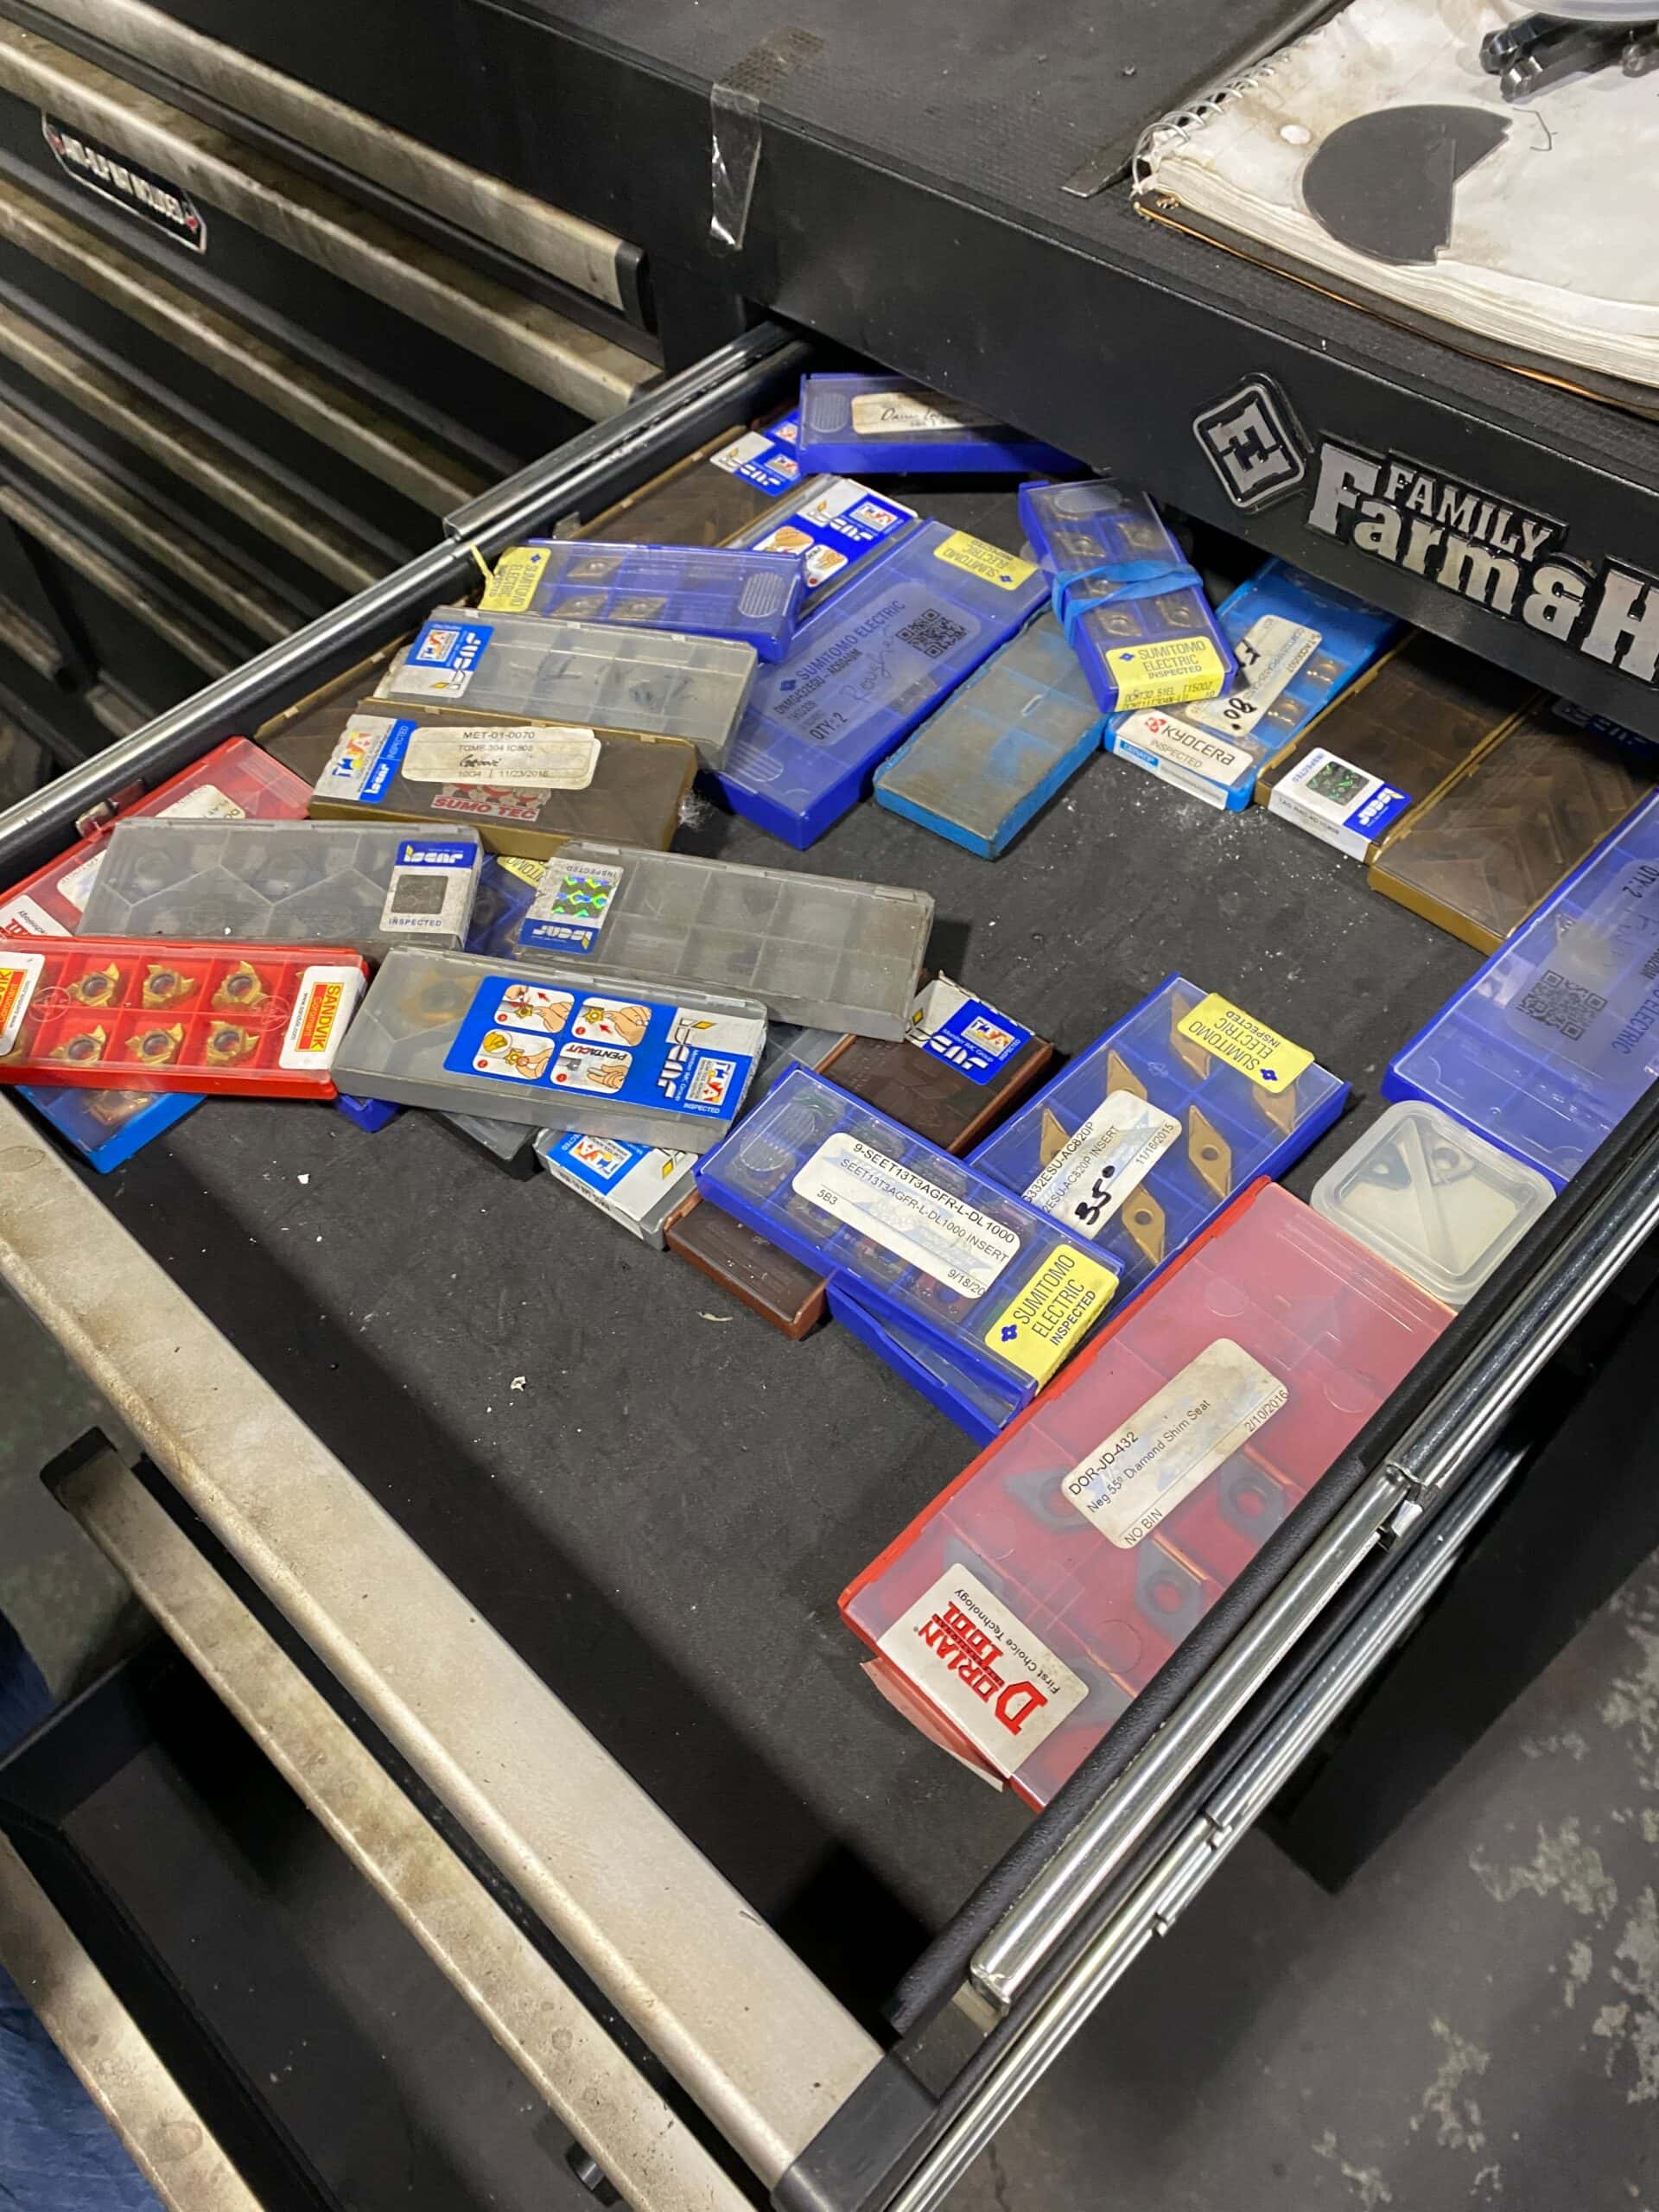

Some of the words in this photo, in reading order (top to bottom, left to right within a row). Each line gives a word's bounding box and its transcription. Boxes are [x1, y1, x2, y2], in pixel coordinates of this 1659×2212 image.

[1382, 460, 1553, 563] FAMILY
[944, 548, 1000, 577] SUMITOMO
[794, 633, 858, 681] SUMITOMO
[855, 601, 906, 637] ELECTRIC
[1138, 640, 1206, 659] SUMITOMO
[1142, 654, 1199, 672] ELECTRIC
[1148, 664, 1202, 679] INSPECTED
[463, 731, 536, 740] MET-01-0070
[1150, 739, 1204, 769] INSPECTED
[434, 796, 493, 813] SUMO
[498, 805, 537, 819] TEC
[566, 865, 618, 878] INSPECTED
[388, 918, 442, 927] INSPECTED
[311, 985, 341, 1049] SANDVIK
[1214, 1016, 1274, 1059] ELECTRIC
[1225, 1010, 1280, 1047] INSPECTED
[566, 1044, 628, 1061] PENTACUT
[1189, 1020, 1260, 1071] SUMITOMO
[683, 1103, 721, 1114] INSPECTED
[1136, 1122, 1174, 1165] 11/16/2015
[1042, 1155, 1090, 1213] 2ESU-AC820P
[1090, 1124, 1120, 1158] INSERT
[817, 1188, 839, 1205] 5B3
[840, 1159, 966, 1238] SEET13T3AGFR-L-DL1000
[965, 1233, 1009, 1263] INSERT
[1013, 1254, 1076, 1325] SUMITOMO
[1032, 1278, 1085, 1338] ELECTRIC
[1050, 1290, 1096, 1346] INSPECTED
[1068, 1430, 1140, 1497] DOR-JD-432
[1087, 1494, 1112, 1514] Neg
[1123, 1440, 1166, 1480] Diamond
[1164, 1421, 1190, 1443] Shim
[1187, 1399, 1211, 1421] Seat
[1124, 1526, 1144, 1546] NO
[1141, 1509, 1164, 1530] BIN
[1244, 1389, 1290, 1433] 2/10/2016
[954, 1588, 1005, 1641] Technology
[1006, 1638, 1038, 1672] Choice
[918, 1620, 1048, 1736] DORIAN
[1037, 1669, 1061, 1694] First
